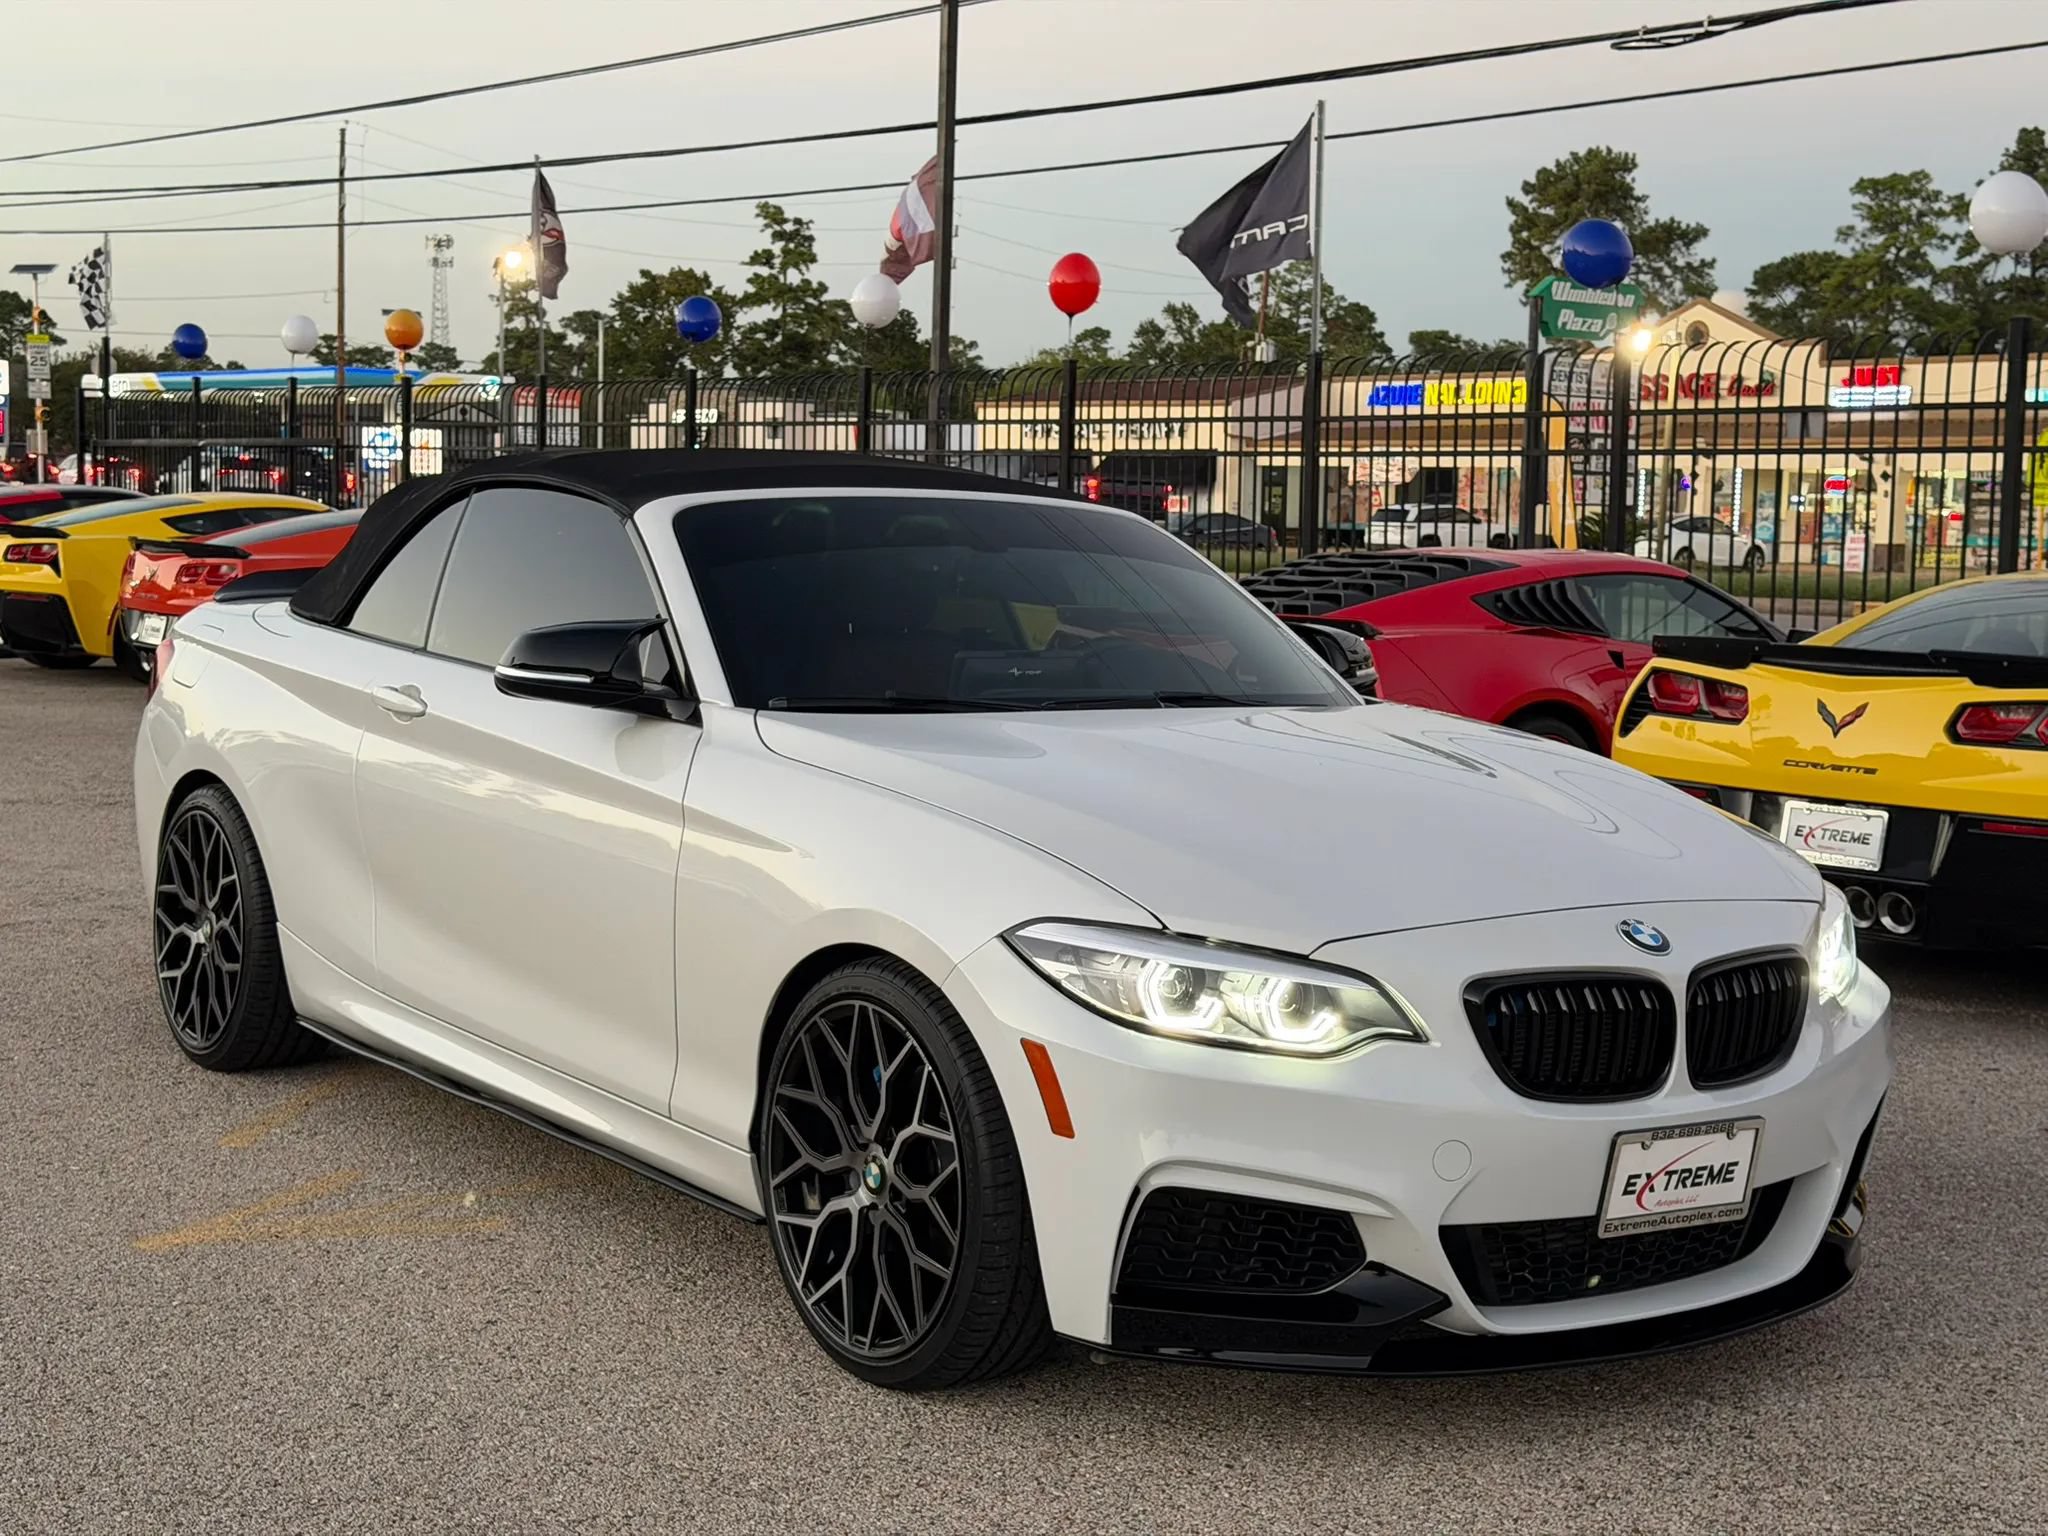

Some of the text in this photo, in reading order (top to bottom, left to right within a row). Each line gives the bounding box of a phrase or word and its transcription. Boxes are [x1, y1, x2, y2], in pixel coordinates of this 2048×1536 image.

[1551, 281, 1635, 308] Wimbledon
[1557, 308, 1604, 333] Plaza
[30, 355, 48, 367] 25
[1783, 759, 1879, 775] CORVETTE
[1794, 824, 1873, 846] EXTREME
[1621, 1160, 1740, 1197] EXTREME
[1603, 1208, 1743, 1233] ExtremeAutoplex.com
